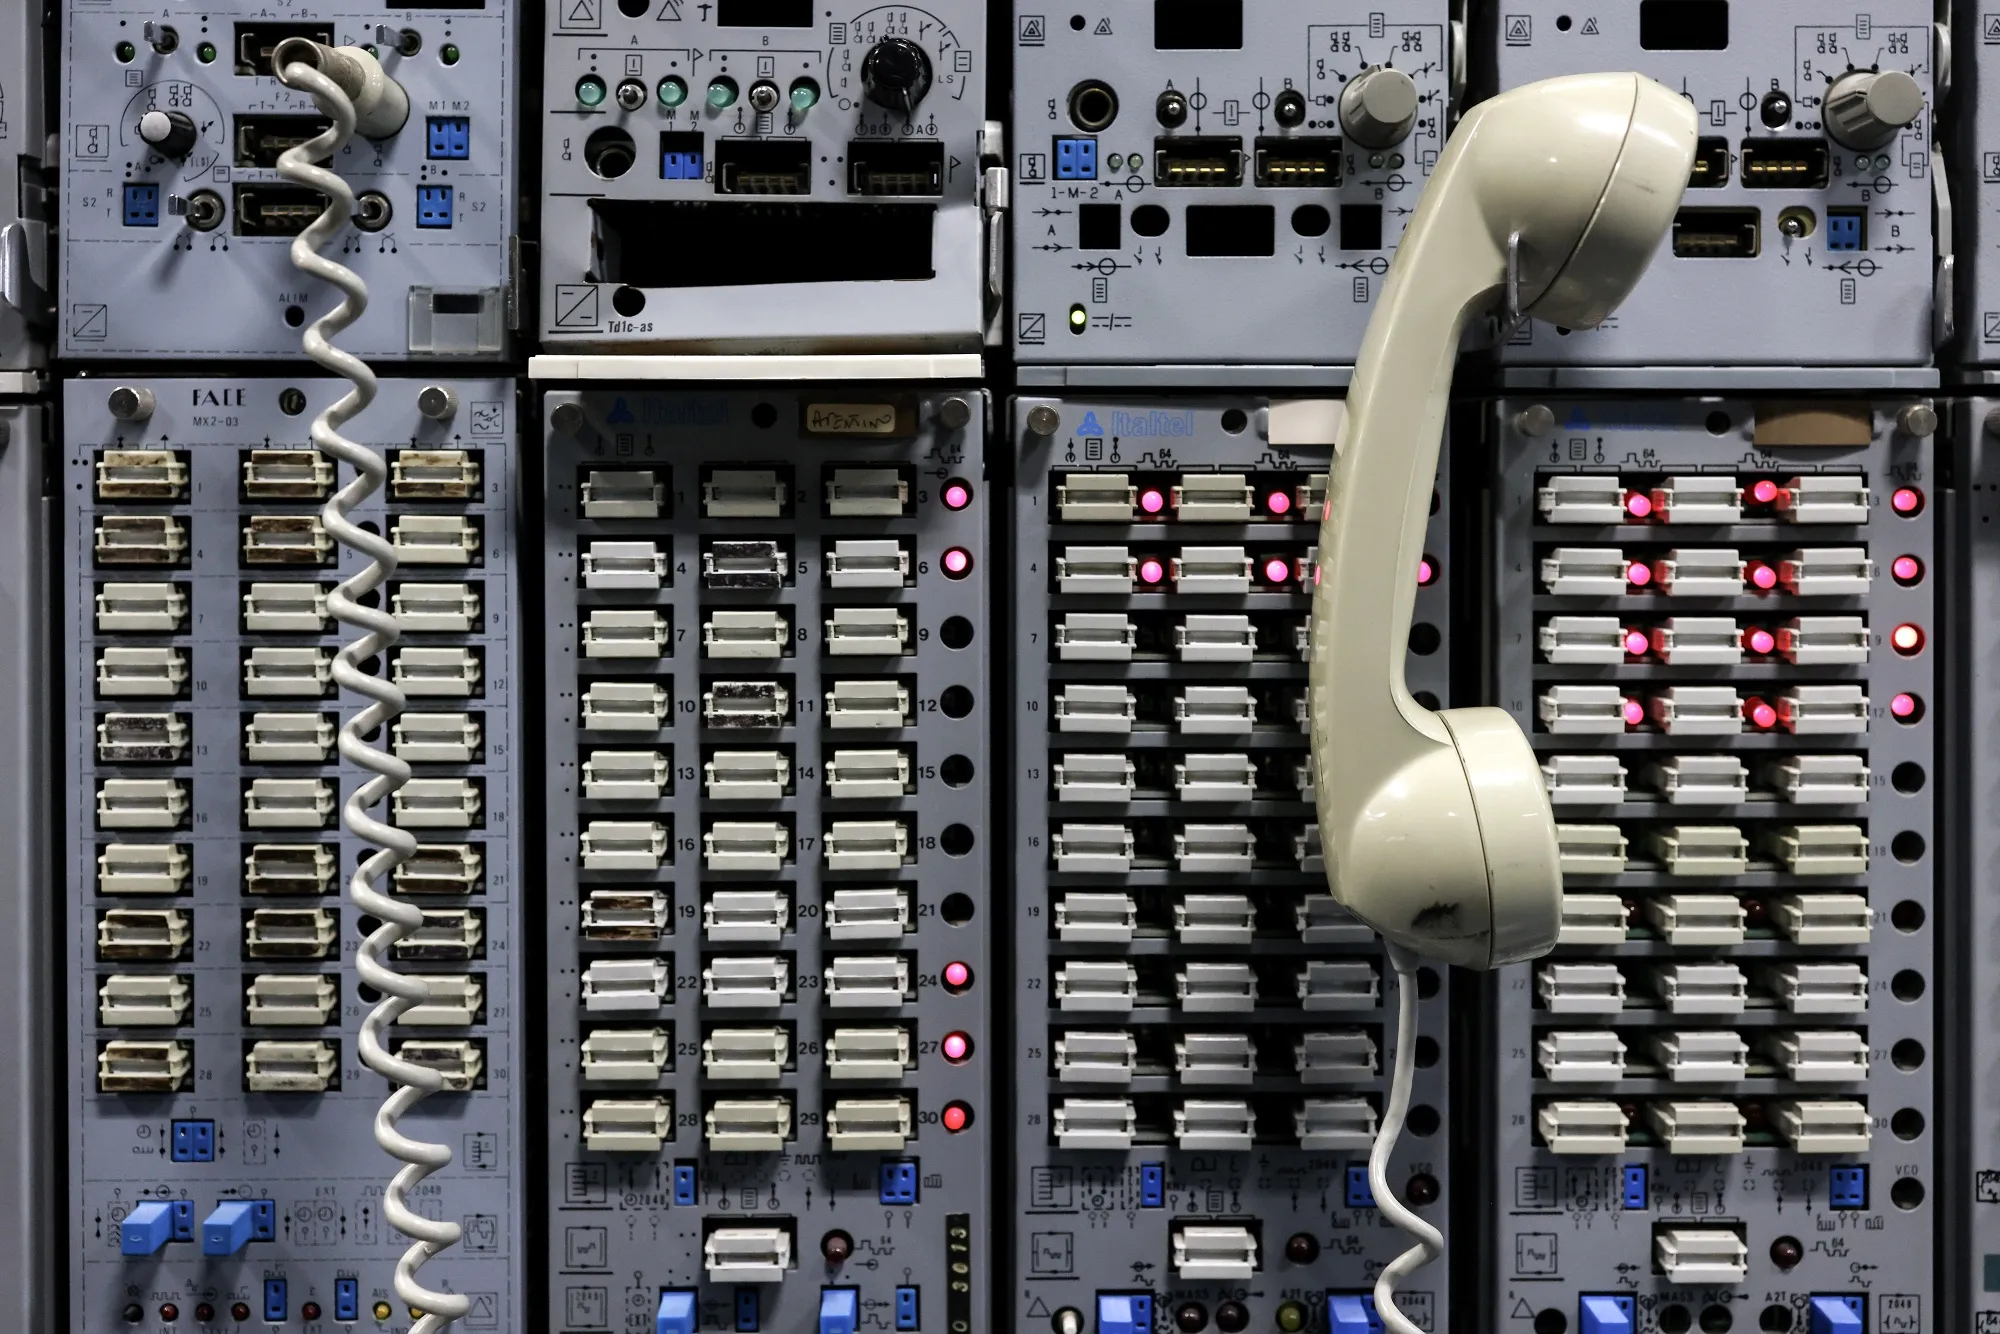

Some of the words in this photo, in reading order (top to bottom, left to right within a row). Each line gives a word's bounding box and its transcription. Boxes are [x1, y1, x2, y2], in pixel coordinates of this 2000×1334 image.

[163, 10, 169, 18] A
[631, 36, 638, 45] A
[762, 36, 769, 46] B
[938, 75, 954, 84] LS
[1285, 79, 1292, 89] B
[1771, 79, 1778, 90] B
[1167, 80, 1173, 90] A
[276, 93, 290, 101] F2
[429, 102, 446, 110] M1
[452, 102, 469, 110] M2
[667, 111, 676, 120] M
[690, 111, 699, 120] M
[691, 122, 697, 131] 2
[870, 125, 876, 134] B
[916, 125, 923, 134] A
[135, 162, 141, 170] A
[431, 166, 437, 175] B
[106, 188, 112, 198] R
[459, 192, 465, 201] R
[1116, 190, 1123, 200] A
[1376, 189, 1383, 199] B
[1862, 190, 1870, 200] B
[82, 197, 96, 207] S2
[472, 202, 486, 212] S2
[1048, 226, 1055, 236] A
[1892, 226, 1899, 237] B
[608, 320, 653, 333] Td1c-as
[1112, 411, 1194, 436] Italtel
[492, 484, 498, 493] 3
[919, 490, 928, 503] 3
[1874, 496, 1880, 506] 3
[197, 549, 203, 559] 4
[347, 550, 353, 559] 5
[493, 550, 499, 558] 6
[677, 562, 686, 574] 4
[798, 562, 807, 574] 5
[919, 562, 928, 574] 6
[1031, 564, 1037, 572] 4
[1874, 567, 1880, 577] 6
[493, 614, 499, 624] 9
[677, 630, 686, 641] 7
[798, 629, 807, 641] 8
[919, 629, 929, 641] 9
[1031, 634, 1037, 643] 7
[1516, 634, 1521, 643] 7
[1876, 636, 1881, 646] 9
[196, 681, 207, 691] 10
[493, 680, 504, 690] 12
[678, 701, 695, 712] 10
[798, 701, 813, 712] 11
[919, 700, 937, 712] 12
[1026, 702, 1038, 711] 10
[1512, 702, 1522, 711] 10
[1873, 708, 1884, 718] 12
[196, 746, 208, 756] 13
[493, 745, 504, 755] 15
[678, 768, 695, 780] 13
[798, 767, 814, 778] 14
[919, 767, 935, 778] 15
[1028, 769, 1039, 779] 13
[1874, 776, 1885, 785] 15
[196, 814, 208, 823] 16
[493, 812, 504, 822] 18
[678, 839, 695, 850] 16
[798, 838, 815, 850] 17
[919, 837, 936, 849] 18
[1028, 837, 1039, 847] 16
[1875, 846, 1886, 856] 18
[197, 875, 208, 886] 19
[493, 875, 504, 885] 21
[679, 906, 695, 918] 19
[798, 906, 818, 917] 20
[919, 905, 935, 916] 21
[1028, 907, 1039, 916] 19
[1875, 913, 1886, 922] 21
[199, 941, 210, 950] 22
[492, 941, 505, 950] 24
[677, 977, 697, 989] 22
[798, 977, 818, 988] 23
[919, 975, 938, 987] 24
[1028, 979, 1040, 989] 22
[1512, 980, 1525, 989] 22
[1875, 982, 1887, 991] 24
[199, 1007, 211, 1017] 25
[346, 1007, 359, 1017] 26
[493, 1006, 505, 1017] 27
[678, 1044, 698, 1055] 25
[799, 1043, 818, 1055] 26
[919, 1042, 938, 1054] 27
[1028, 1049, 1041, 1058] 25
[1513, 1049, 1525, 1058] 25
[1875, 1051, 1887, 1060] 27
[199, 1070, 212, 1080] 28
[346, 1070, 359, 1080] 29
[494, 1070, 506, 1079] 30
[678, 1115, 698, 1126] 28
[800, 1113, 819, 1125] 29
[919, 1112, 938, 1124] 30
[1028, 1115, 1040, 1125] 28
[1873, 1120, 1888, 1129] 30
[1410, 1163, 1432, 1173] VCO
[1895, 1165, 1918, 1175] VCO
[1832, 1238, 1844, 1247] 64
[372, 1288, 388, 1298] AIS
[1888, 1300, 1912, 1308] 2048
